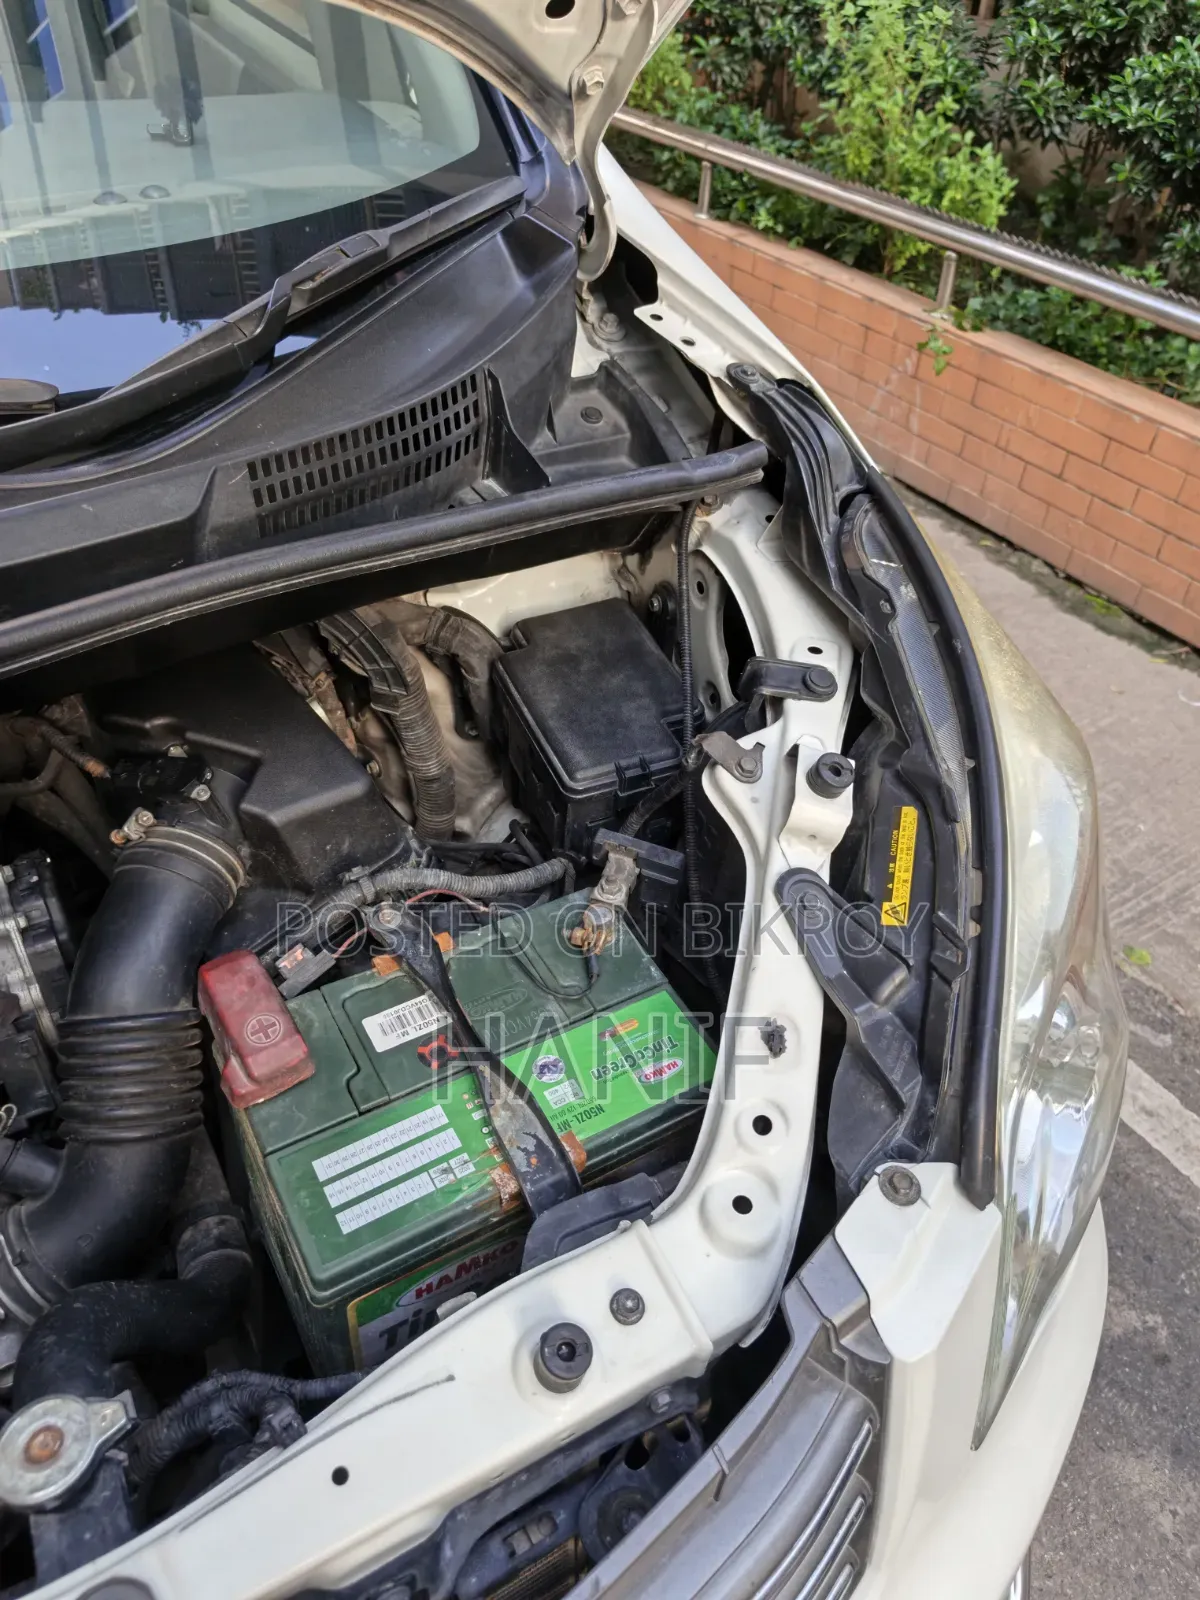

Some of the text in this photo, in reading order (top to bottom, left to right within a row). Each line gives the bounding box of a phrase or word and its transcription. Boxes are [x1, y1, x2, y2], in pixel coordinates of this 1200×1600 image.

[890, 829, 898, 855] CAUTION
[394, 1029, 409, 1039] MF
[591, 1035, 678, 1082] TinCaGreen
[644, 1060, 679, 1081] HAMKO
[554, 1102, 605, 1133] N50ZL-MF
[415, 1239, 519, 1299] HAMKO
